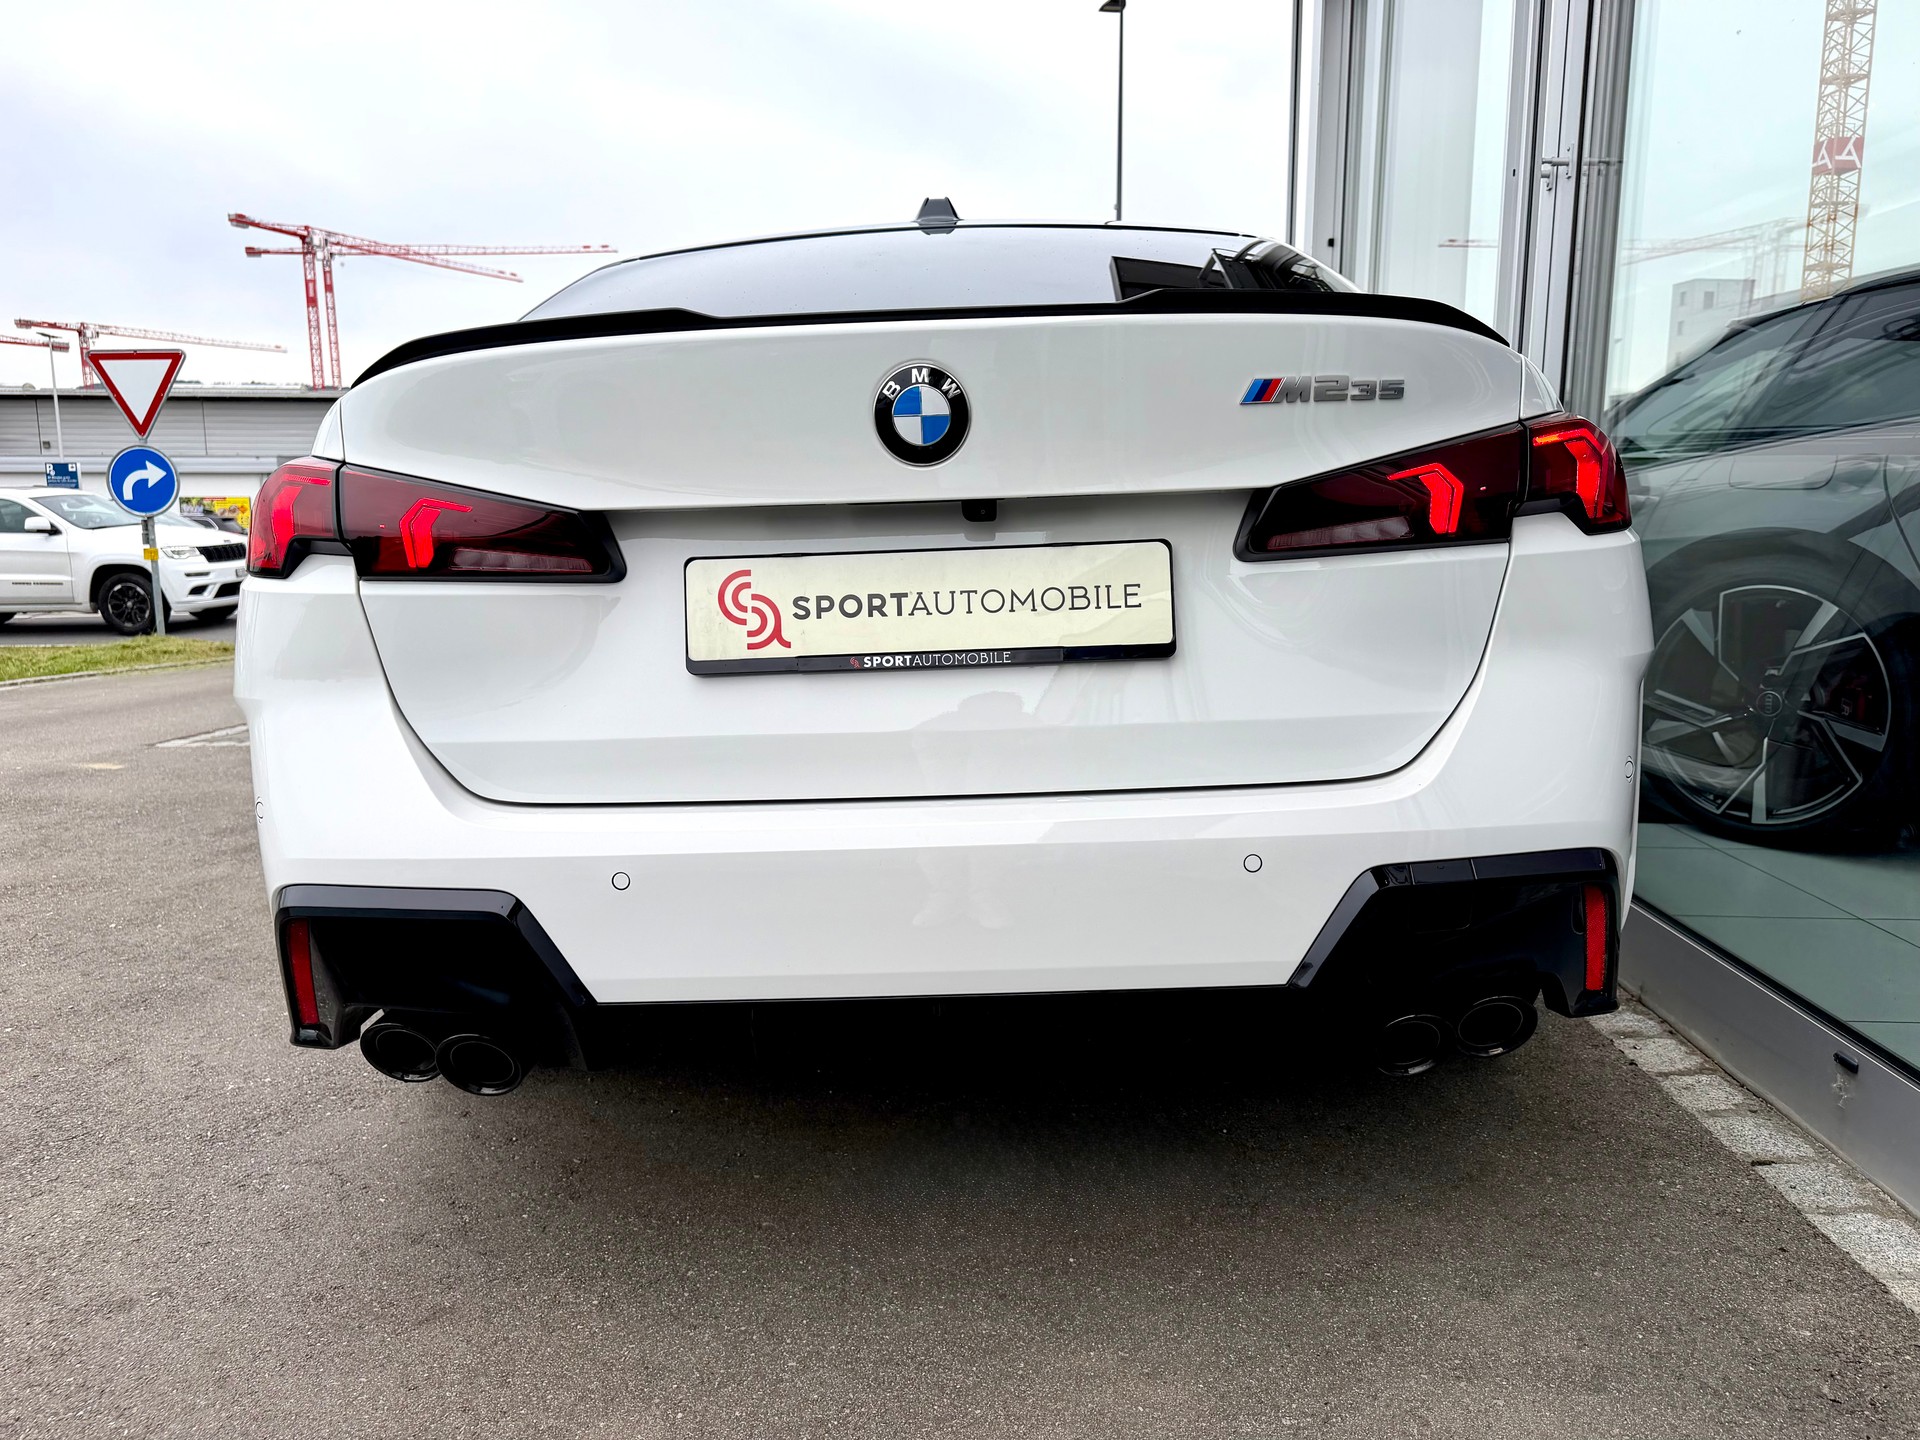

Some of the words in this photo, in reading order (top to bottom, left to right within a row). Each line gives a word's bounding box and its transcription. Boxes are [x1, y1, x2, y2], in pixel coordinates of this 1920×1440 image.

[882, 367, 962, 401] BMW
[1274, 375, 1405, 403] M235
[792, 583, 1142, 620] SPORTAUTOMOBILE
[863, 651, 1012, 668] SPORTAUTOMOBILE
